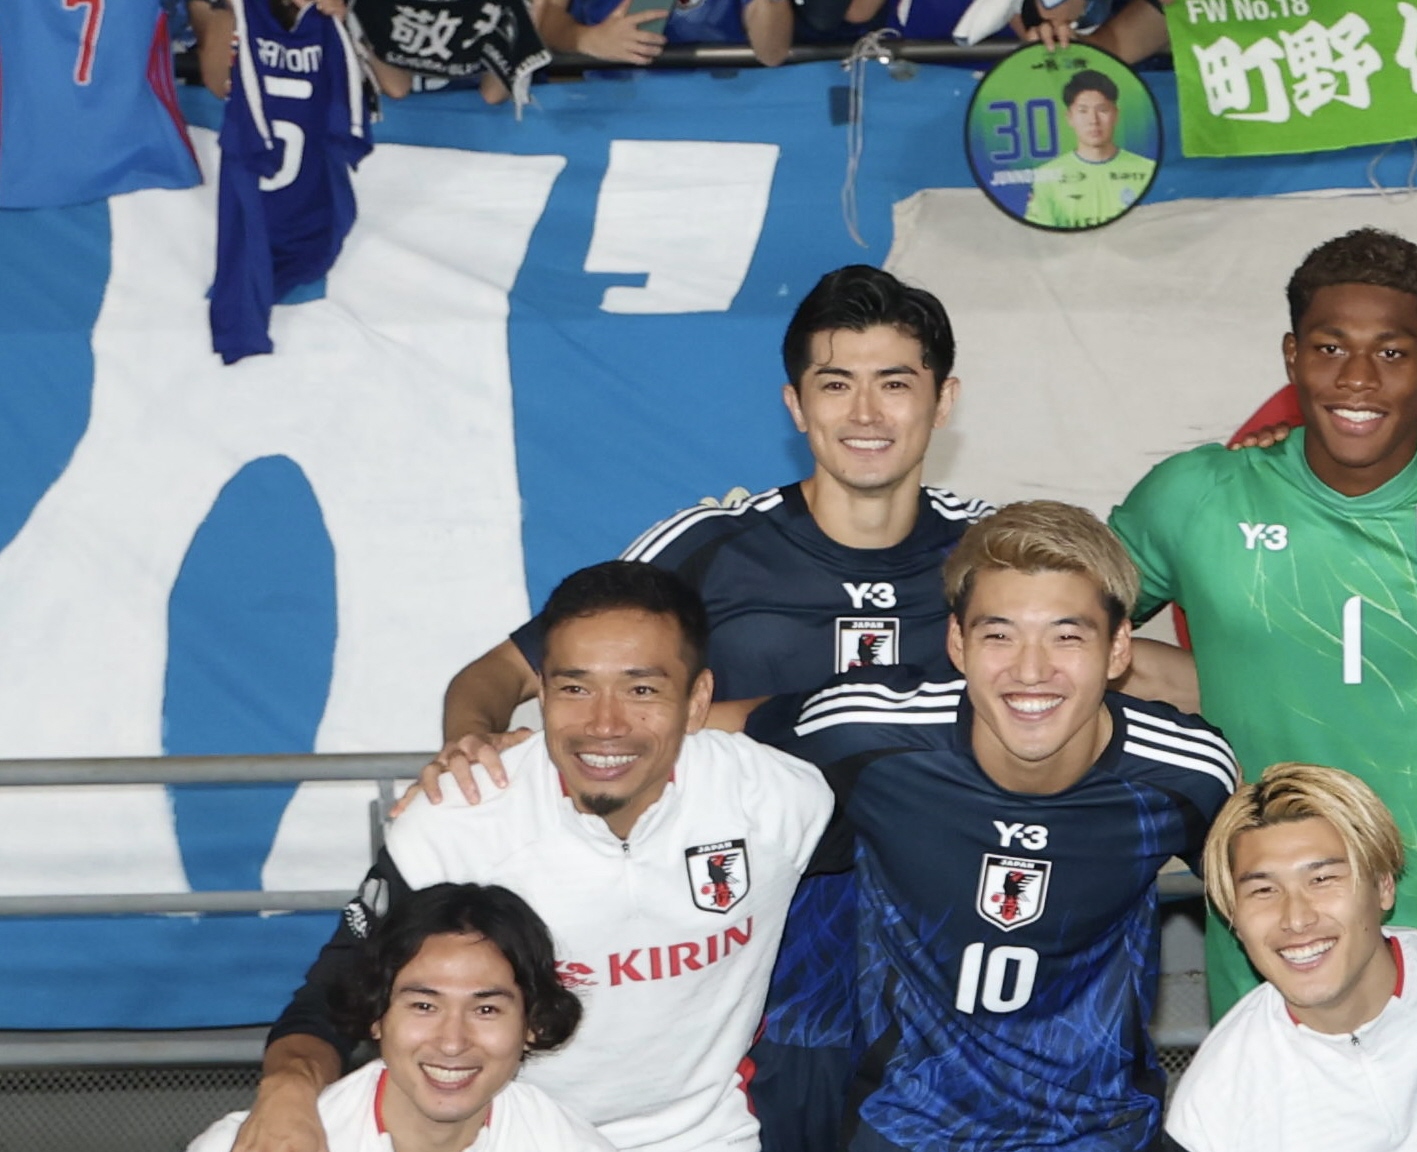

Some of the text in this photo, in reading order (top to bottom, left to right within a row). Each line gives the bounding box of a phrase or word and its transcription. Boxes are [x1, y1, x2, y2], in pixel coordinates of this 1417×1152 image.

[1187, 0, 1229, 24] FW
[1192, 12, 1384, 123] 町野
[988, 98, 1060, 162] 30
[1237, 522, 1289, 551] Y-3
[842, 582, 897, 609] Y-3
[851, 621, 885, 630] JAPAN
[1342, 595, 1362, 685] 1
[696, 841, 733, 855] JAPAN
[992, 820, 1050, 851] Y-3
[999, 858, 1035, 870] JAPAN
[608, 915, 754, 988] KIRIN
[955, 941, 1040, 1015] 10
